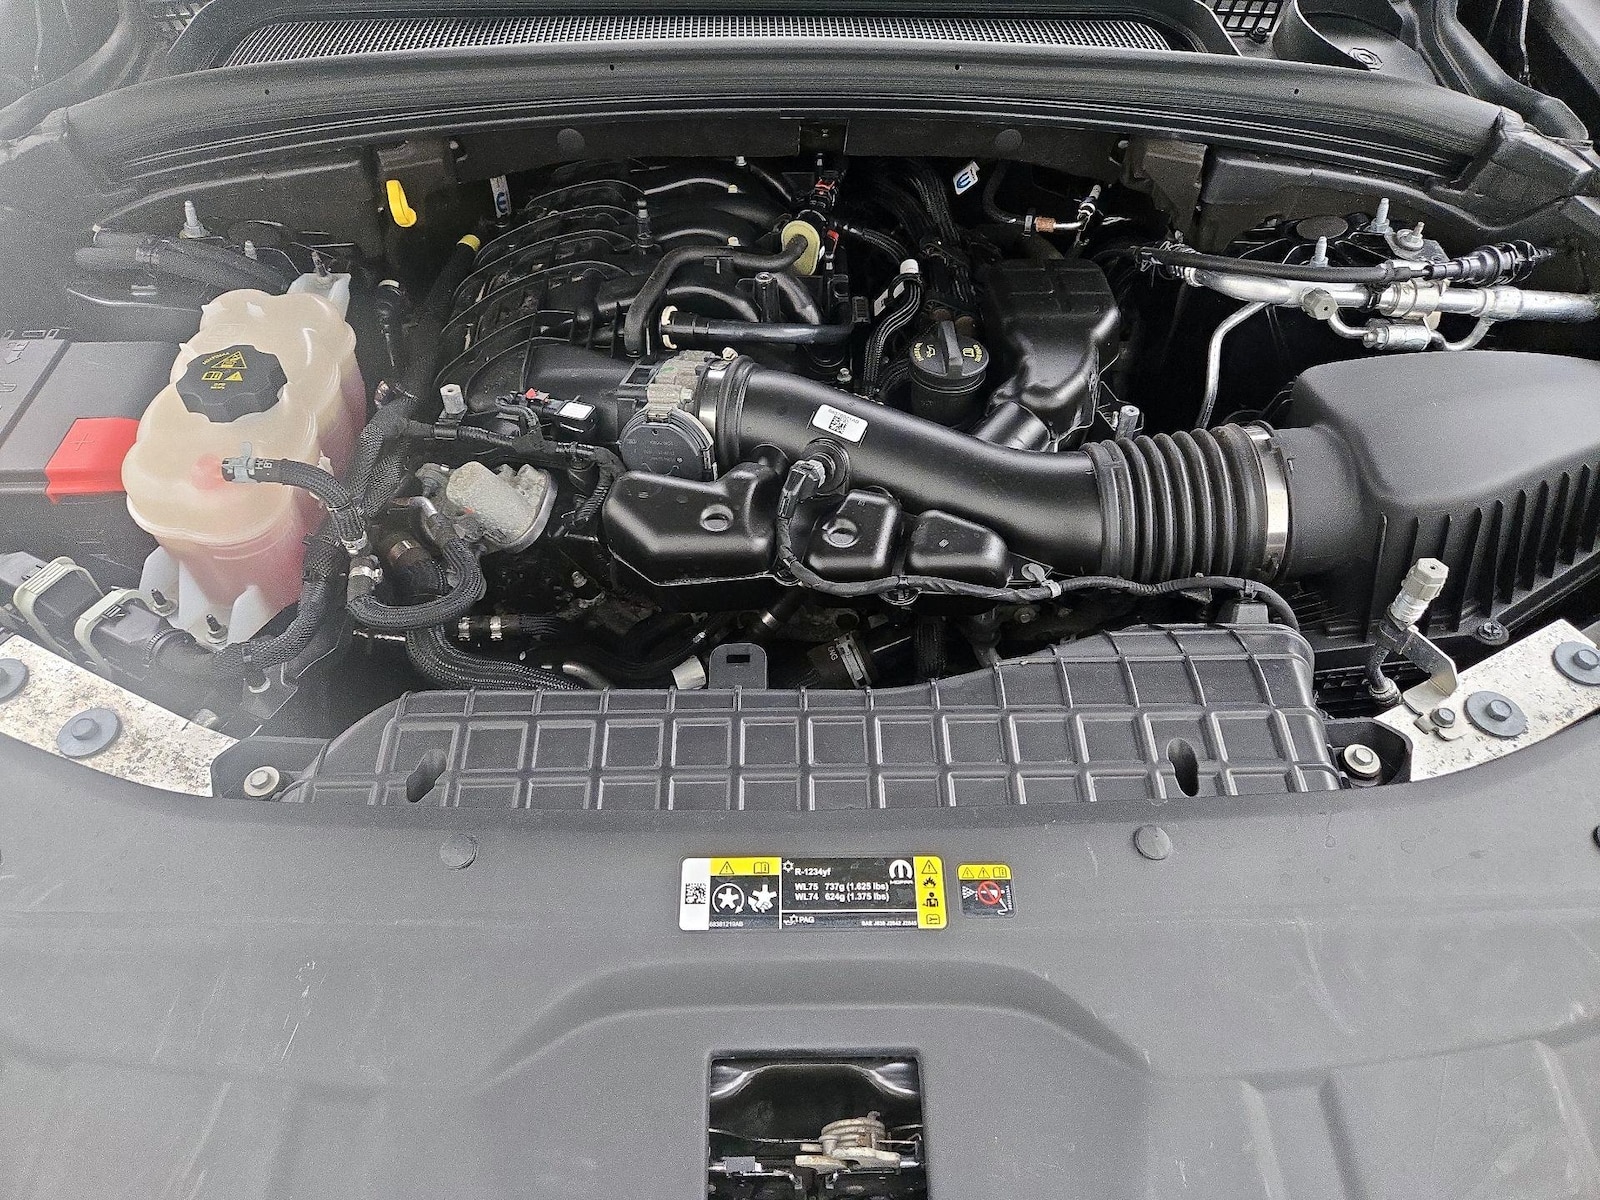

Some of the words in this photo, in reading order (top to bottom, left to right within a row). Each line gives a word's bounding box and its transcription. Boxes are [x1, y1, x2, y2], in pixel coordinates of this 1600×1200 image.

[794, 867, 832, 878] R-1234yf
[794, 882, 819, 891] WL75
[824, 882, 846, 892] 737g
[846, 882, 872, 892] (1.625
[872, 881, 890, 892] lbs)
[794, 892, 820, 901] WL74
[824, 892, 846, 902] 624g
[846, 892, 873, 902] (1.375
[873, 892, 890, 902] lbs)
[799, 916, 815, 924] PAG
